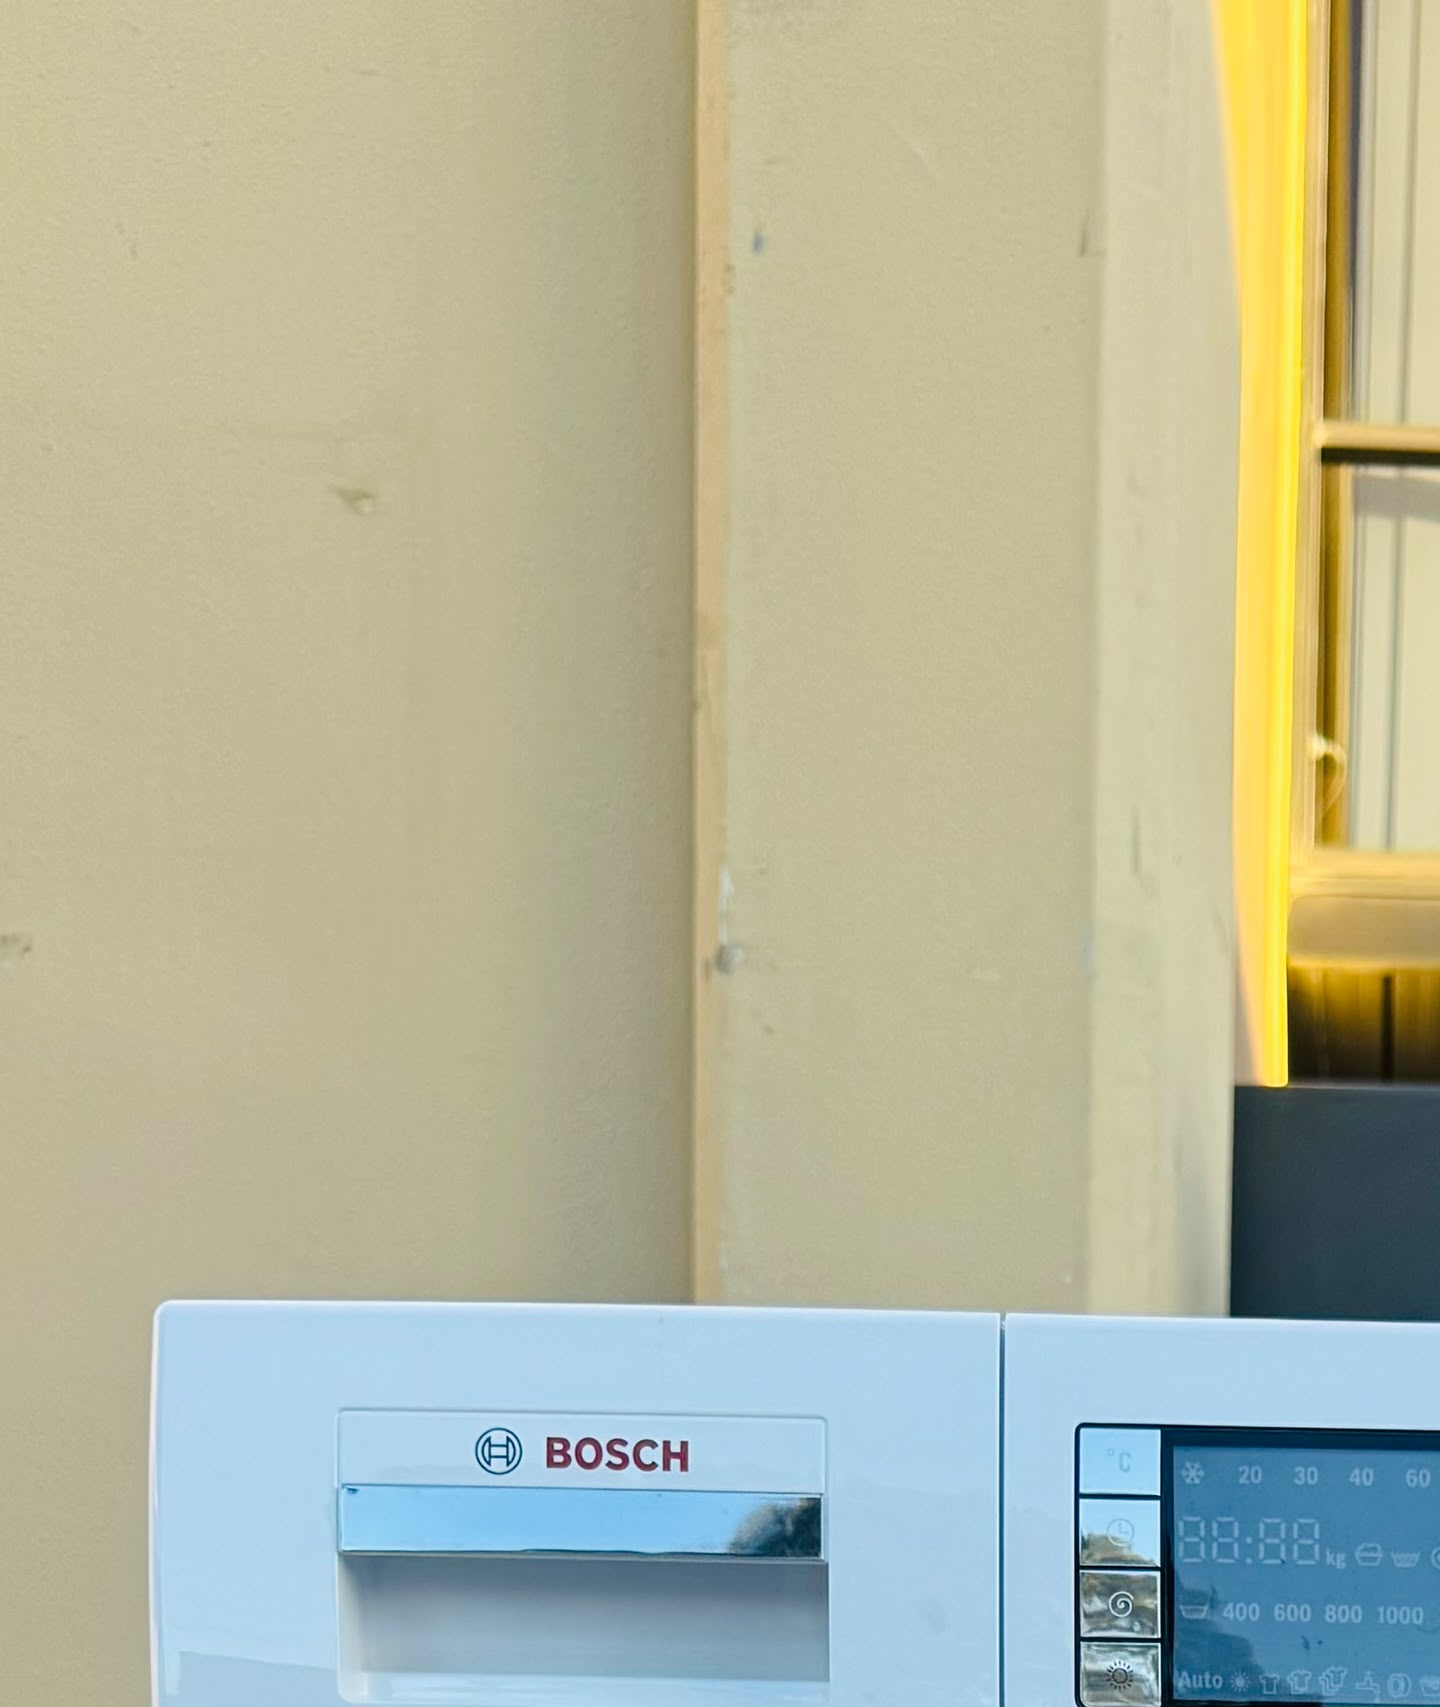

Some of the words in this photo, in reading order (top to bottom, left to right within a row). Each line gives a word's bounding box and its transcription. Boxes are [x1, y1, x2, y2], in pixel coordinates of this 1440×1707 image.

[546, 1437, 689, 1473] BOSCH
[1239, 1465, 1262, 1484] 20
[1294, 1466, 1318, 1485] 30
[1349, 1467, 1374, 1487] 40
[1406, 1468, 1431, 1488] 60
[1326, 1549, 1346, 1569] kg
[1222, 1603, 1260, 1622] 400
[1274, 1604, 1311, 1623] 600
[1325, 1605, 1362, 1624] 800
[1378, 1606, 1423, 1625] 1000
[1178, 1670, 1223, 1691] Auto
